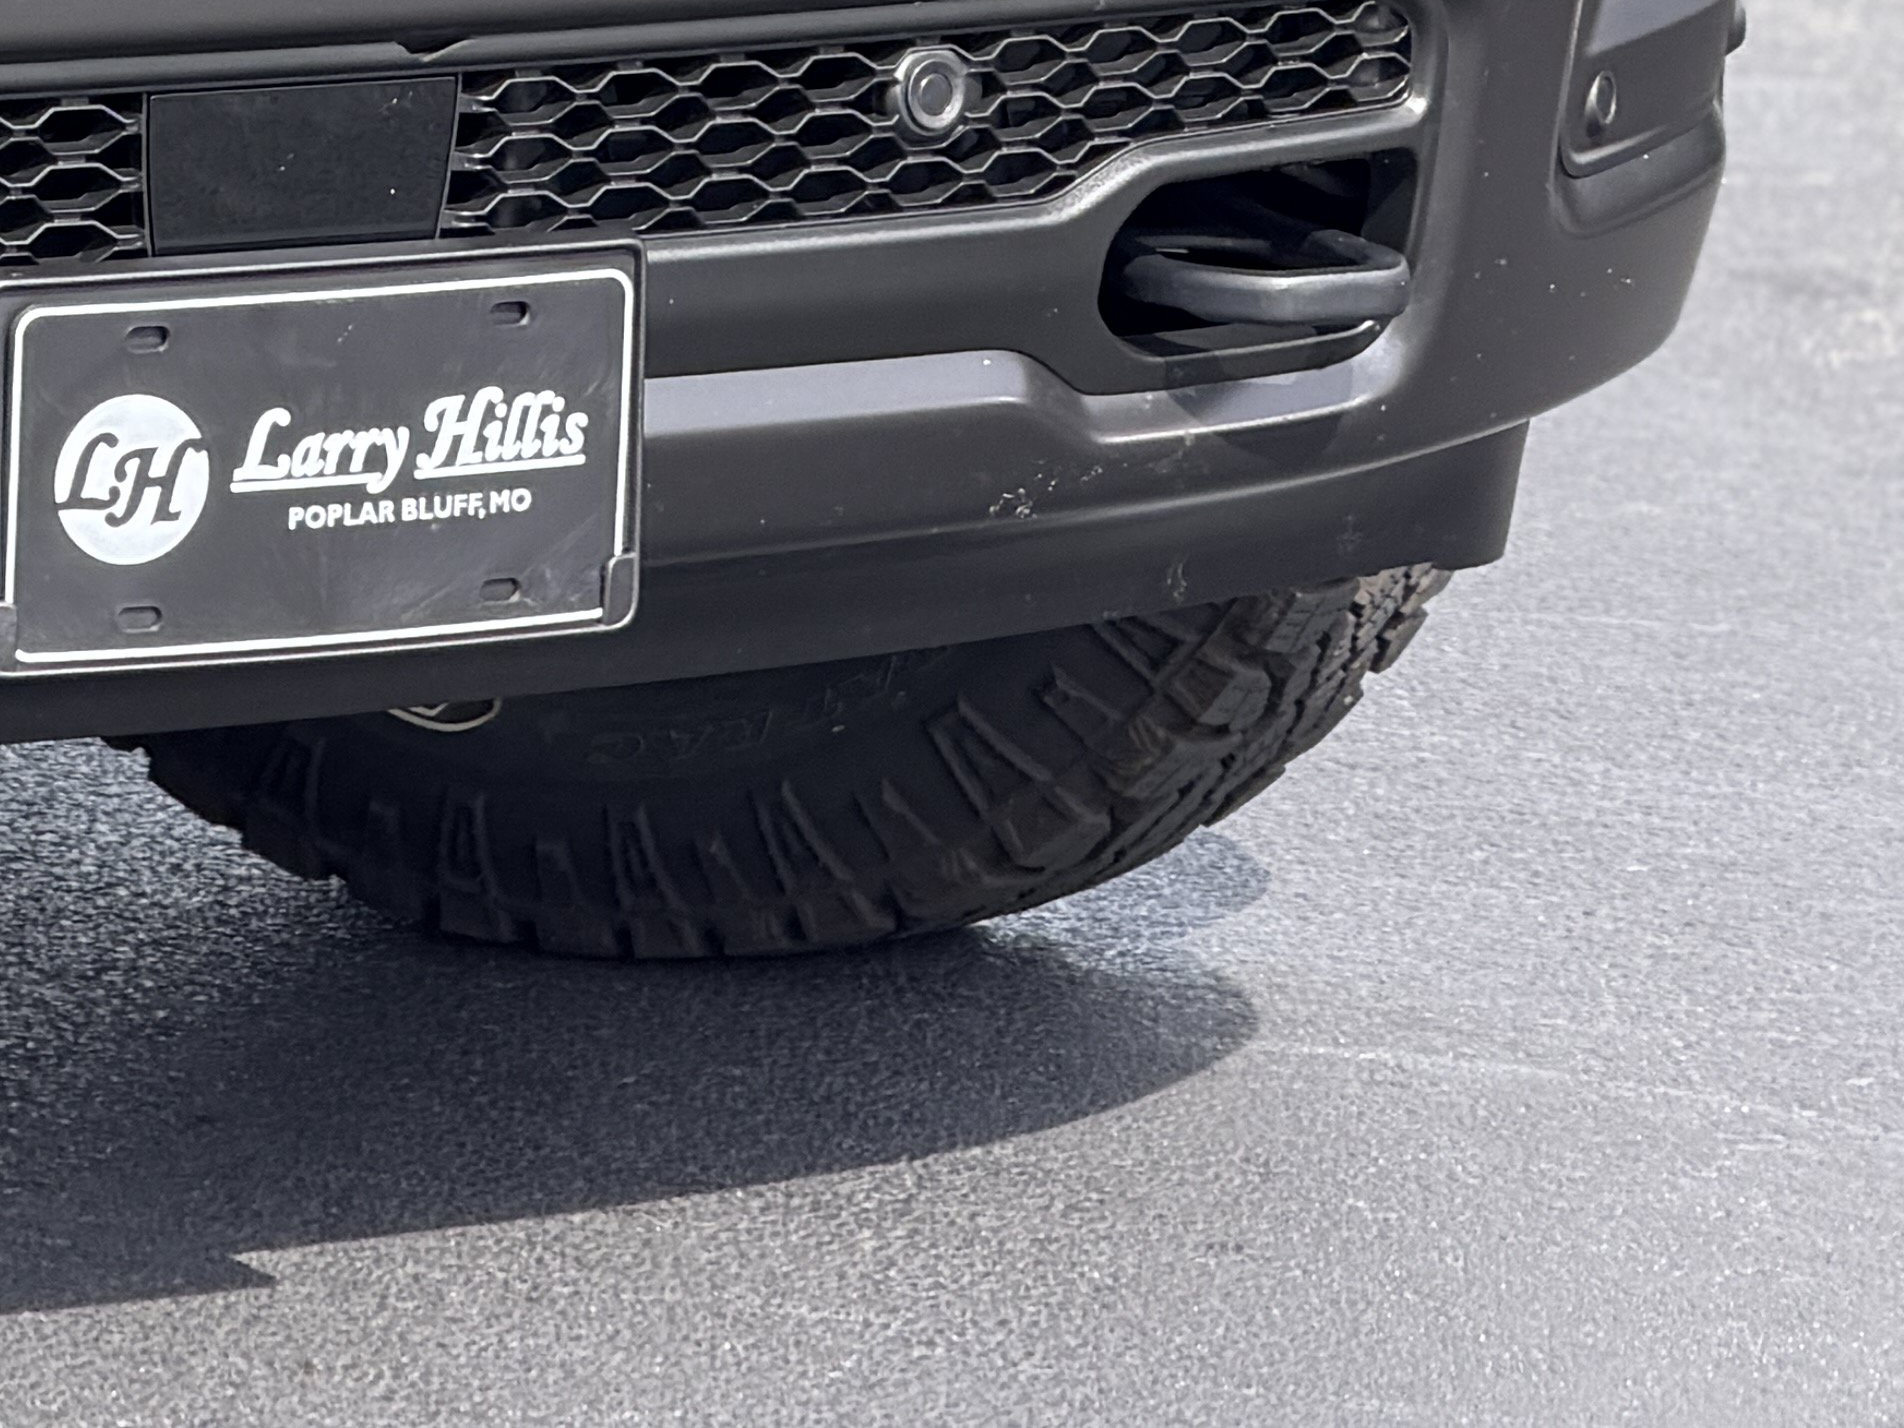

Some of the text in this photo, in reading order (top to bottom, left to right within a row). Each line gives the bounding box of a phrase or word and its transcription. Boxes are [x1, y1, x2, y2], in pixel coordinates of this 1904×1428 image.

[56, 432, 205, 529] LH
[231, 386, 589, 493] Larry Hillis
[288, 498, 395, 530] POPLAR
